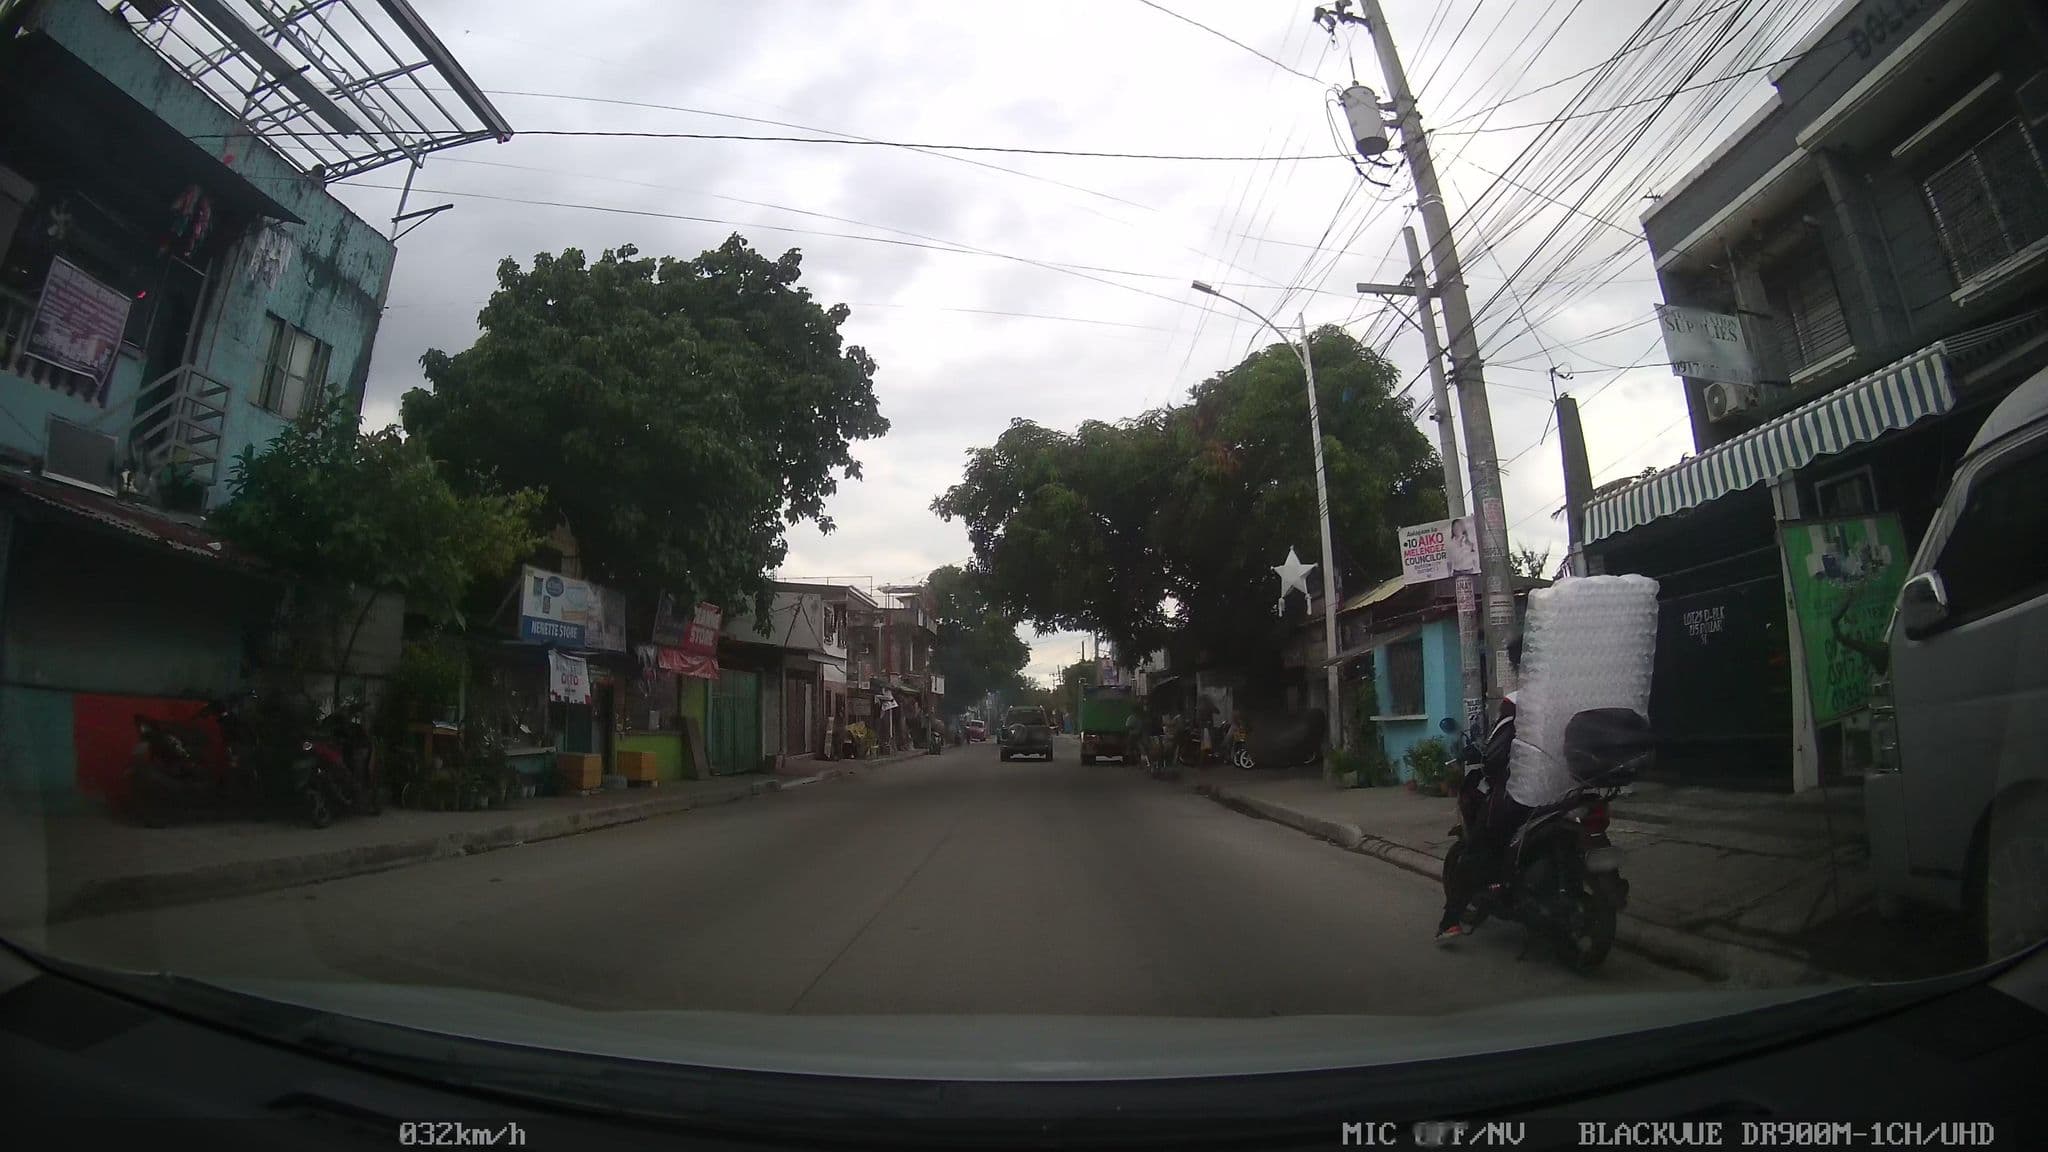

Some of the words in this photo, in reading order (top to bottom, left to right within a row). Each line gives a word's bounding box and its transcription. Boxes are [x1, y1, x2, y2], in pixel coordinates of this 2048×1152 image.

[1664, 316, 1738, 343] SUPLIES
[1419, 532, 1444, 547] AIKO
[1404, 543, 1445, 558] MELENDEZ
[1405, 552, 1447, 566] COUNCILOR
[559, 624, 578, 640] STORE
[560, 673, 579, 686] DITO
